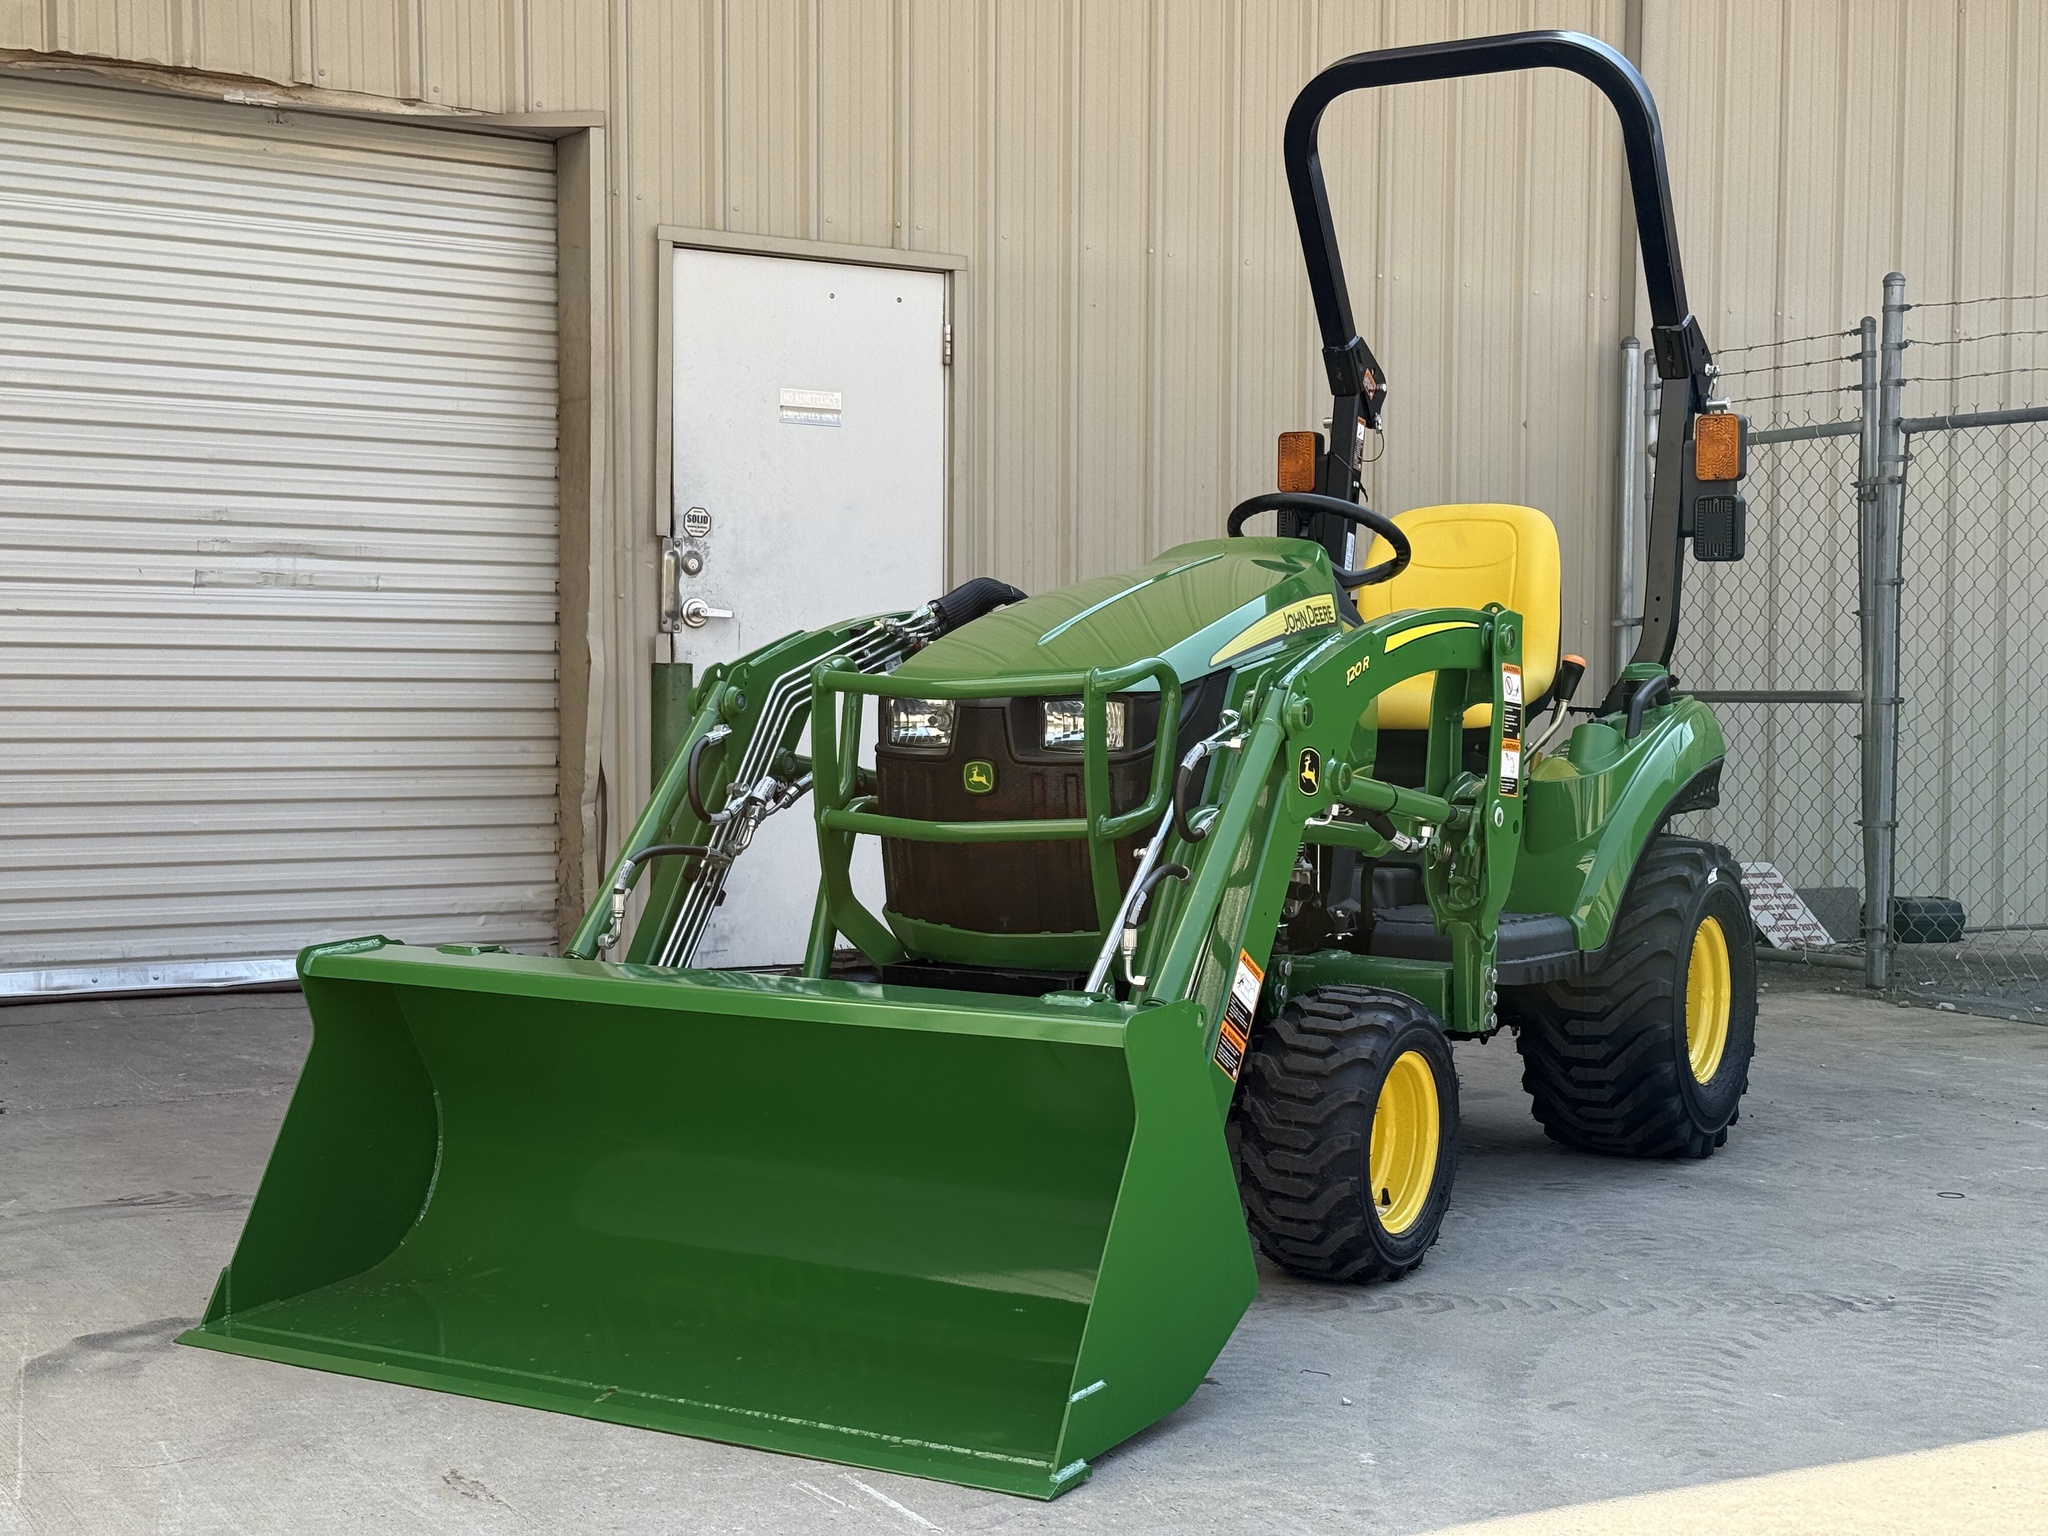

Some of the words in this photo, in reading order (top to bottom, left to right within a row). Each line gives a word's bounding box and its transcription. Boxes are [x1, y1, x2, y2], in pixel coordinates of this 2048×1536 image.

[782, 391, 794, 403] NO
[795, 392, 838, 406] ADMITTANCE
[687, 514, 708, 525] SOLID
[1283, 609, 1309, 633] JOHN
[1306, 604, 1334, 625] DEERE
[1771, 913, 1796, 921] CALL
